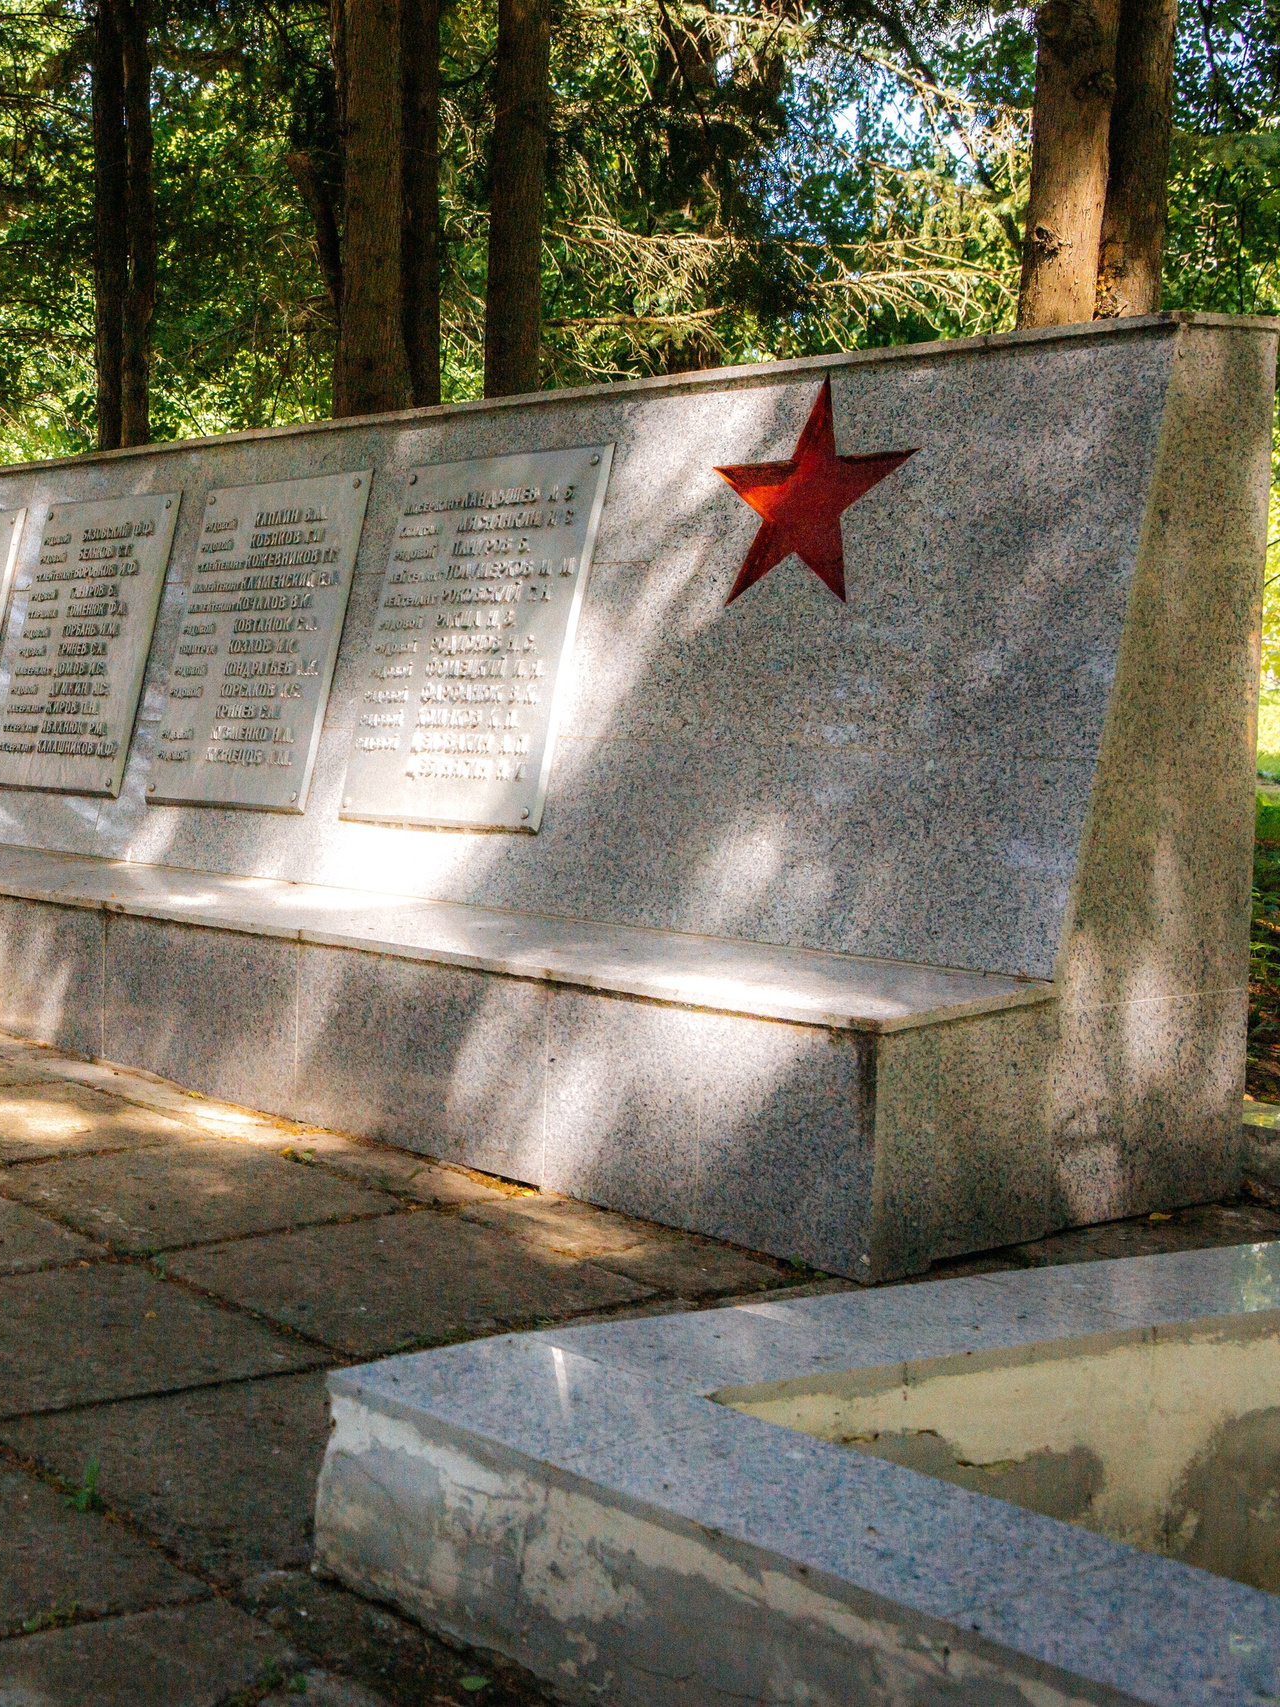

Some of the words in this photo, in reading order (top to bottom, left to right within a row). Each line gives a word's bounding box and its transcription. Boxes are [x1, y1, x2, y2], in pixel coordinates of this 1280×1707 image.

[250, 529, 302, 548] КОБЯКОВ
[244, 549, 318, 568] КОЖЕВНИКОВ
[227, 639, 272, 653] КОЗЛОВ
[223, 660, 293, 677] КОНДРАТЬЕВ
[219, 683, 276, 697] КОРСАКОВ
[36, 739, 95, 757] КАЛАШНИКОВ
